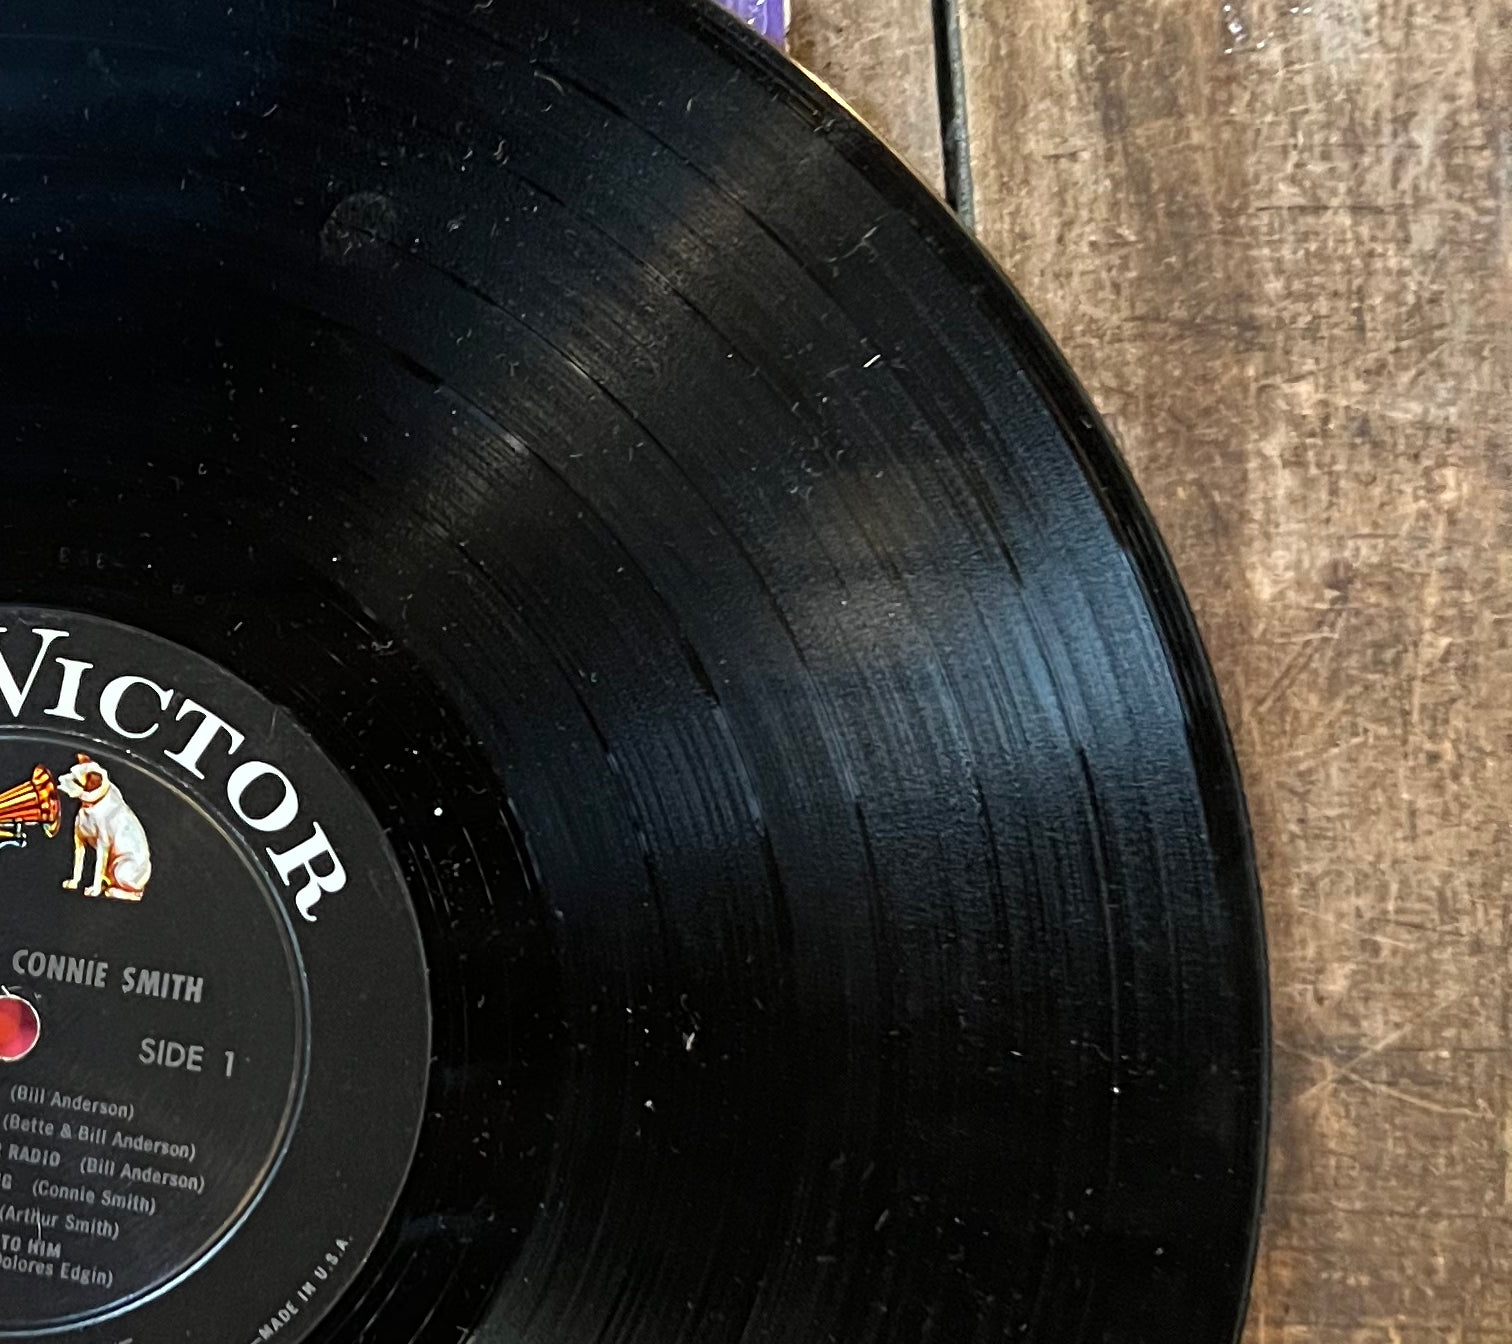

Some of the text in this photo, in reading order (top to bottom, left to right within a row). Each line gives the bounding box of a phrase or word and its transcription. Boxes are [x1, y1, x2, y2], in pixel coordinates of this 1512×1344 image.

[12, 949, 109, 988] CONNIE
[122, 966, 204, 1004] SMITH
[138, 1037, 235, 1078] SIDE 1
[10, 1083, 45, 1105] (Bill
[50, 1091, 135, 1122] Anderson)
[2, 1113, 55, 1136] (Bette
[60, 1123, 72, 1139] &
[78, 1125, 107, 1145] Bill
[111, 1131, 196, 1163] Anderson)
[8, 1143, 61, 1168] RADIO
[79, 1156, 115, 1176] (Bill
[120, 1163, 206, 1195] Anderson)
[32, 1178, 95, 1205] (Connie
[101, 1189, 156, 1216] Smith)
[0, 1203, 59, 1228] (Arthur
[64, 1213, 119, 1241] Smith)
[1, 1232, 22, 1252] TO
[27, 1237, 62, 1259] HIM
[60, 1261, 113, 1289] Edgin)
[297, 1281, 317, 1302] IN
